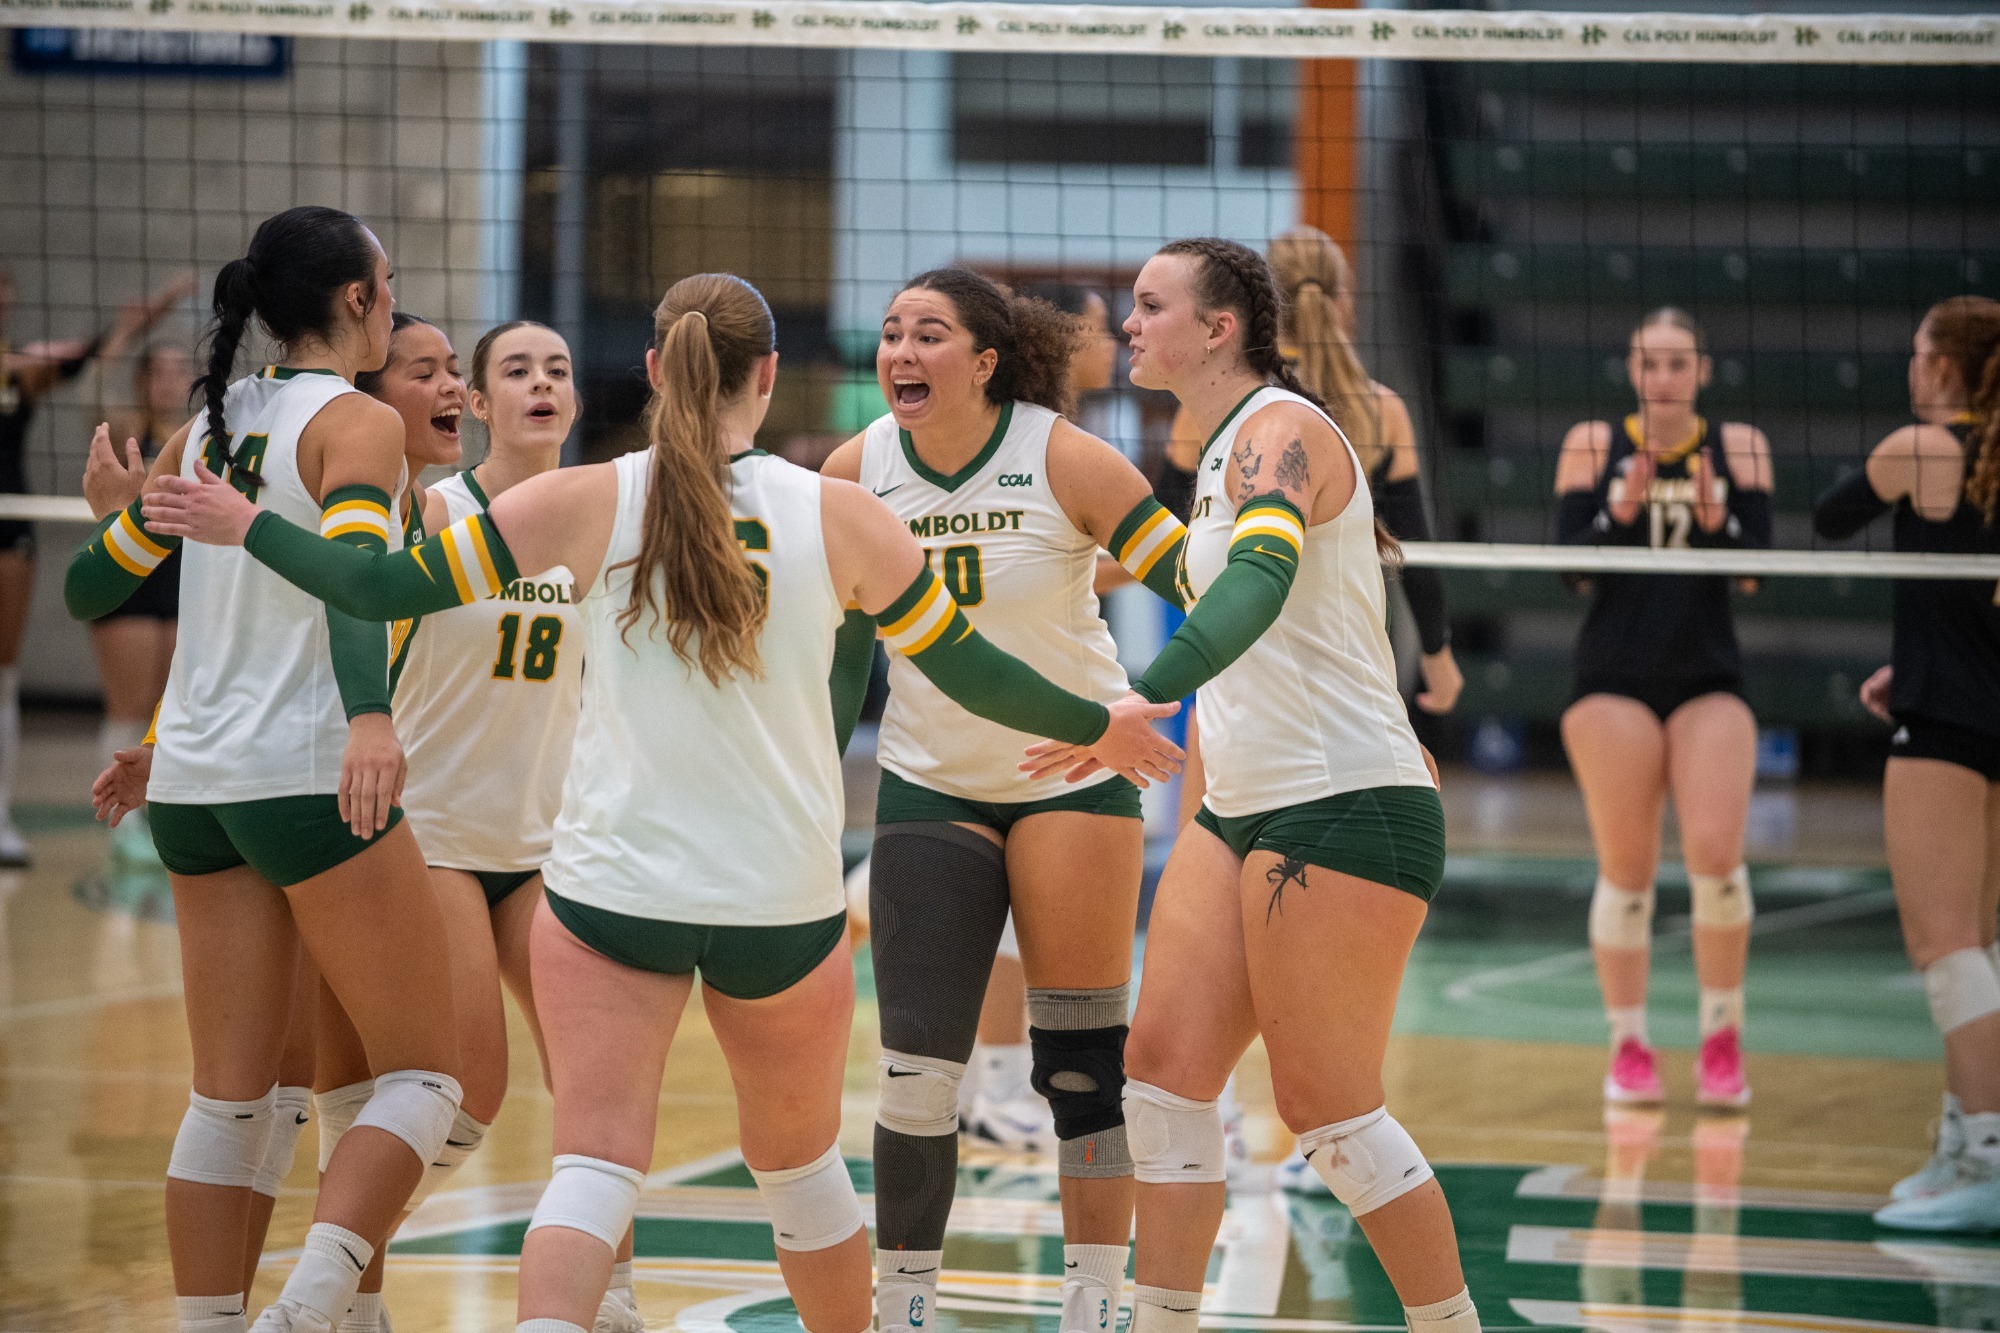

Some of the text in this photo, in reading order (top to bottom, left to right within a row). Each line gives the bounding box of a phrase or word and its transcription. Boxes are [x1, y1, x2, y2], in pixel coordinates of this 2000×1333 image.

[187, 1, 333, 17] CAL POLY HUMBOLDT
[388, 7, 534, 22] CAL POLY HUMBOLDT
[589, 11, 736, 25] CAL POLY HUMBOLDT
[791, 14, 940, 30] CAL POLY HUMBOLDT
[997, 20, 1148, 36] CAL POLY HUMBOLDT
[1203, 24, 1355, 38] CAL POLY HUMBOLDT
[1411, 26, 1565, 40] CAL POLY HUMBOLDT
[1623, 29, 1778, 43] CAL POLY HUMBOLDT
[1837, 31, 1996, 45] CAL POLY HUMBOLDT
[998, 473, 1033, 487] CCAA
[905, 510, 1024, 538] MBOLDT
[922, 543, 985, 608] 0
[486, 581, 573, 604] MBOL
[491, 612, 564, 682] 18
